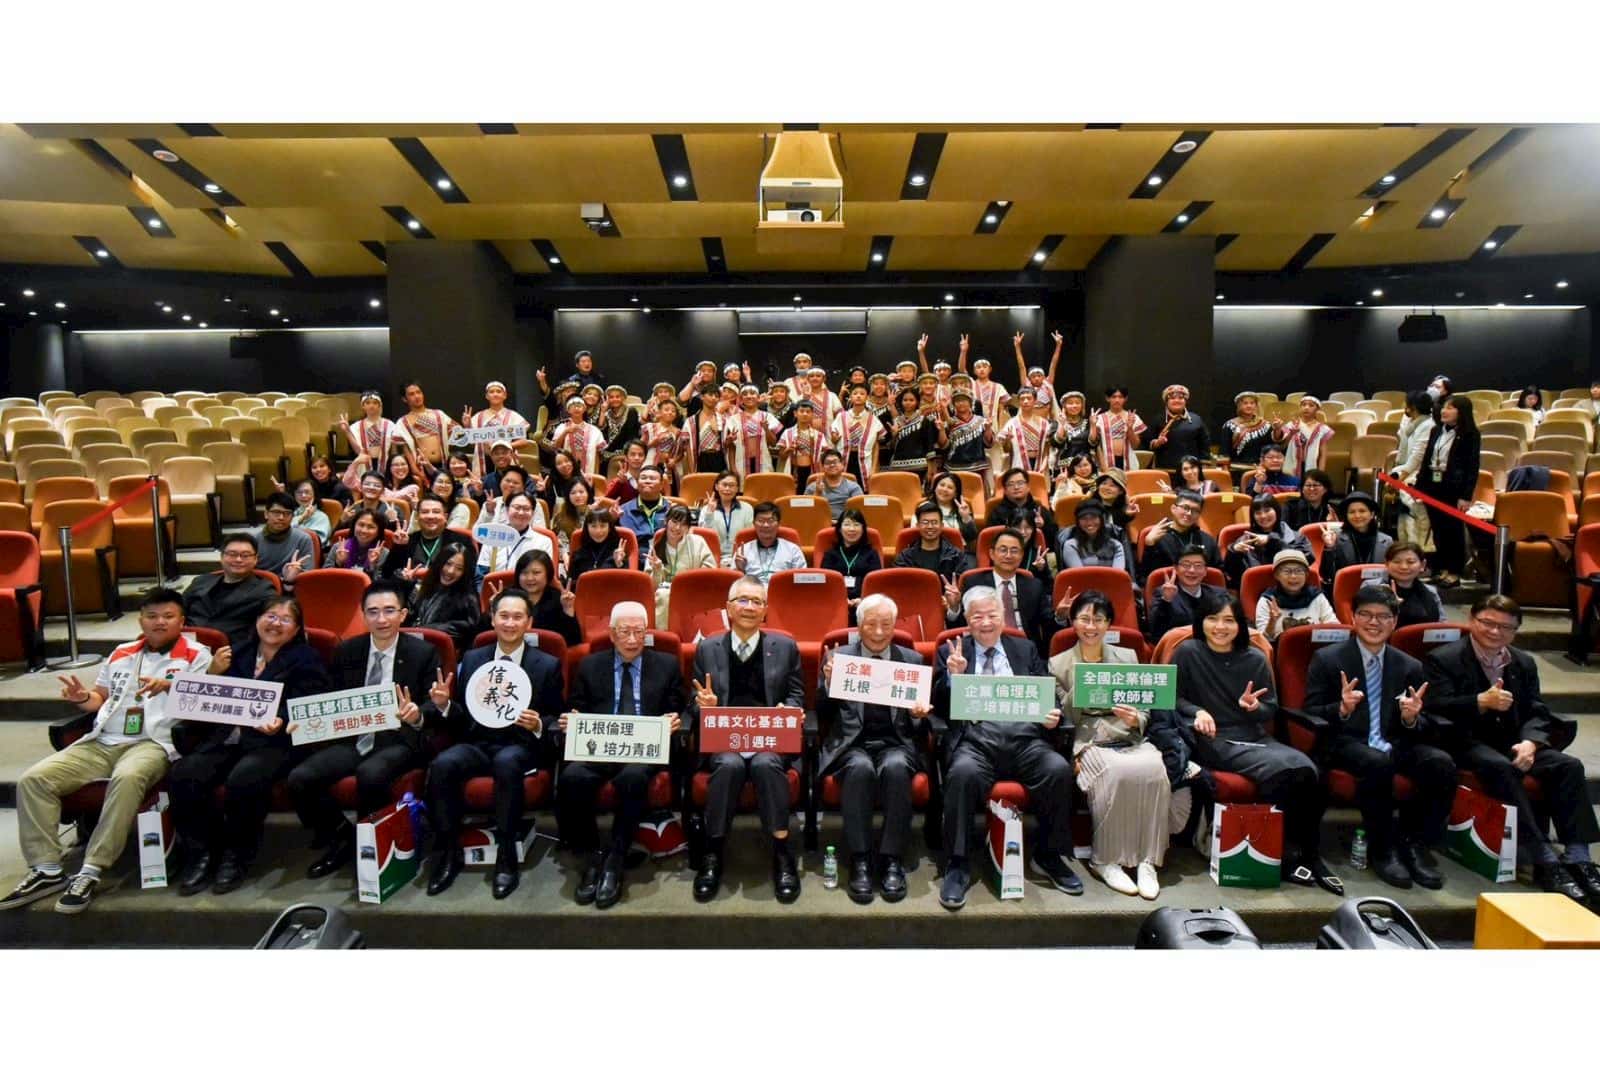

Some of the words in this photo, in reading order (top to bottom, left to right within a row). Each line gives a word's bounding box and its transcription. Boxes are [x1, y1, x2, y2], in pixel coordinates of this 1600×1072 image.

[845, 661, 873, 677] 企業
[893, 668, 920, 684] 倫理
[1083, 671, 1169, 687] 全國企業倫理
[843, 678, 871, 695] 扎根
[496, 681, 520, 721] 文化
[1112, 689, 1155, 705] 教師營
[200, 701, 245, 716] 系列講座
[332, 711, 387, 732] 獎助學金
[577, 720, 635, 737] 扎根倫理
[703, 715, 798, 729] 信義文化基金會
[604, 741, 660, 758] 培力青創
[729, 732, 777, 750] 31週年
